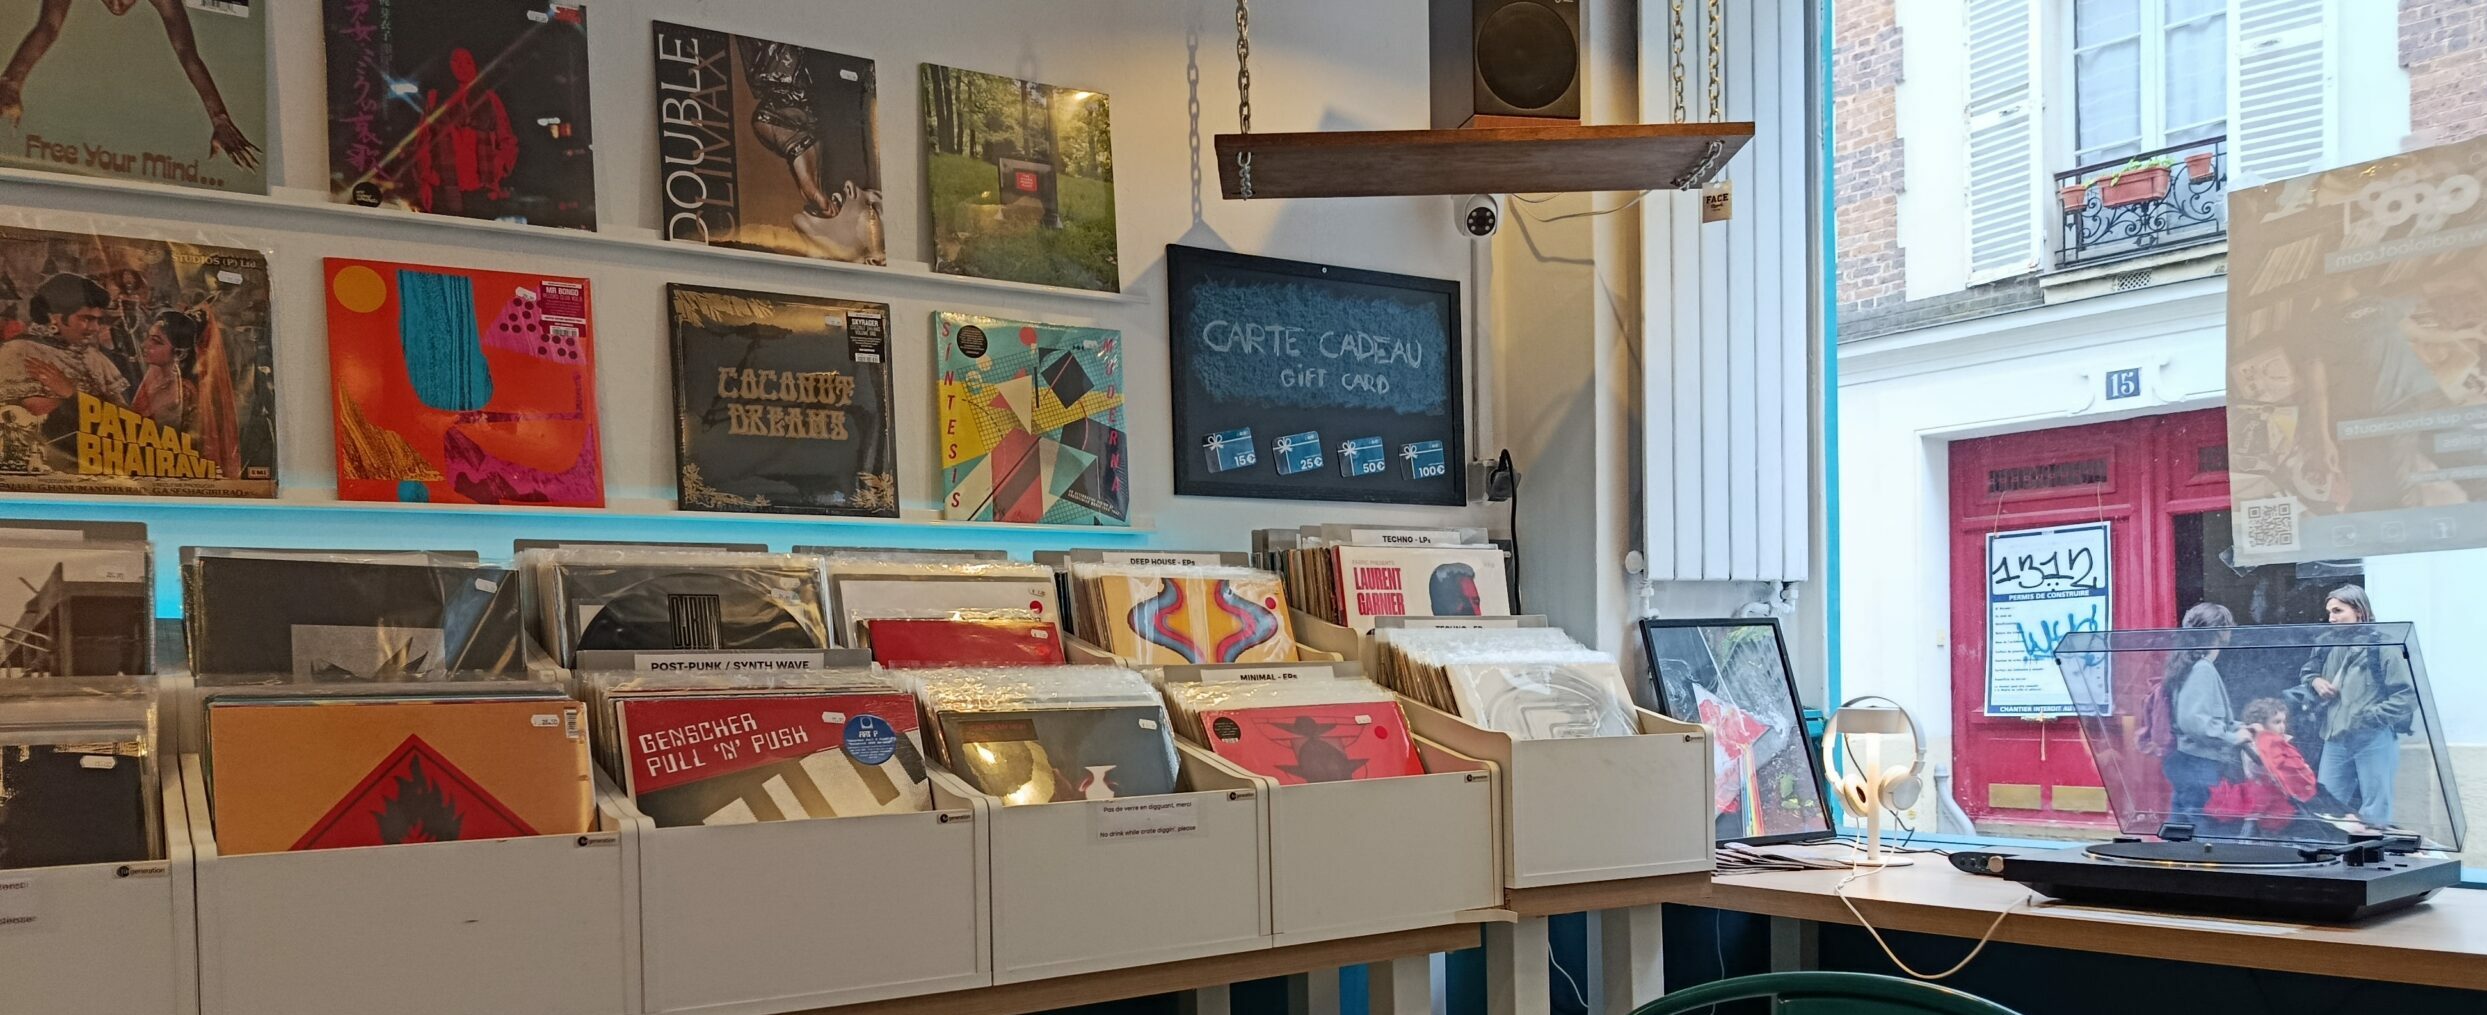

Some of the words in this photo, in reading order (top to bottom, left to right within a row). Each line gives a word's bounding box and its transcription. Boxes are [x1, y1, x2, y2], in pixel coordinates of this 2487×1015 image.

[658, 33, 709, 246] DOUBLE
[687, 45, 735, 241] CLIMAX
[25, 134, 78, 165] Free
[83, 142, 136, 173] Your
[1706, 193, 1729, 204] FACE
[222, 259, 238, 267] (P)
[545, 286, 557, 294] MR
[558, 287, 579, 297] BONGO
[1202, 320, 1304, 357] CARTE
[1319, 331, 1422, 369] CADEAU
[717, 366, 856, 407] COCONUT
[1341, 373, 1390, 395] CARD
[2111, 371, 2136, 398] 15
[78, 391, 200, 457] PATAAL
[727, 402, 849, 441] DREAMS
[77, 431, 217, 479] BHAIRAVI
[1234, 453, 1256, 467] 15€
[1300, 456, 1323, 470] 25€
[1362, 461, 1386, 473] 50€
[1418, 464, 1446, 478] 100€
[1382, 535, 1413, 543] TECHNO
[1419, 536, 1431, 544] LPs
[1151, 558, 1177, 566] HOUSE
[1353, 567, 1402, 591] LAURENT
[1357, 592, 1406, 616] GARNIER
[2047, 589, 2090, 599] CONSTRUIRE
[651, 661, 722, 671] POST-PUNK
[733, 661, 773, 670] SYNTH
[776, 660, 810, 670] WAVE
[1240, 673, 1276, 681] MINIMAL
[1999, 705, 2032, 713] CHANTIER
[2033, 705, 2062, 713] INTERDIT
[638, 713, 758, 754] GENSCHER
[646, 749, 707, 777] PULL
[751, 725, 809, 754] PUSH
